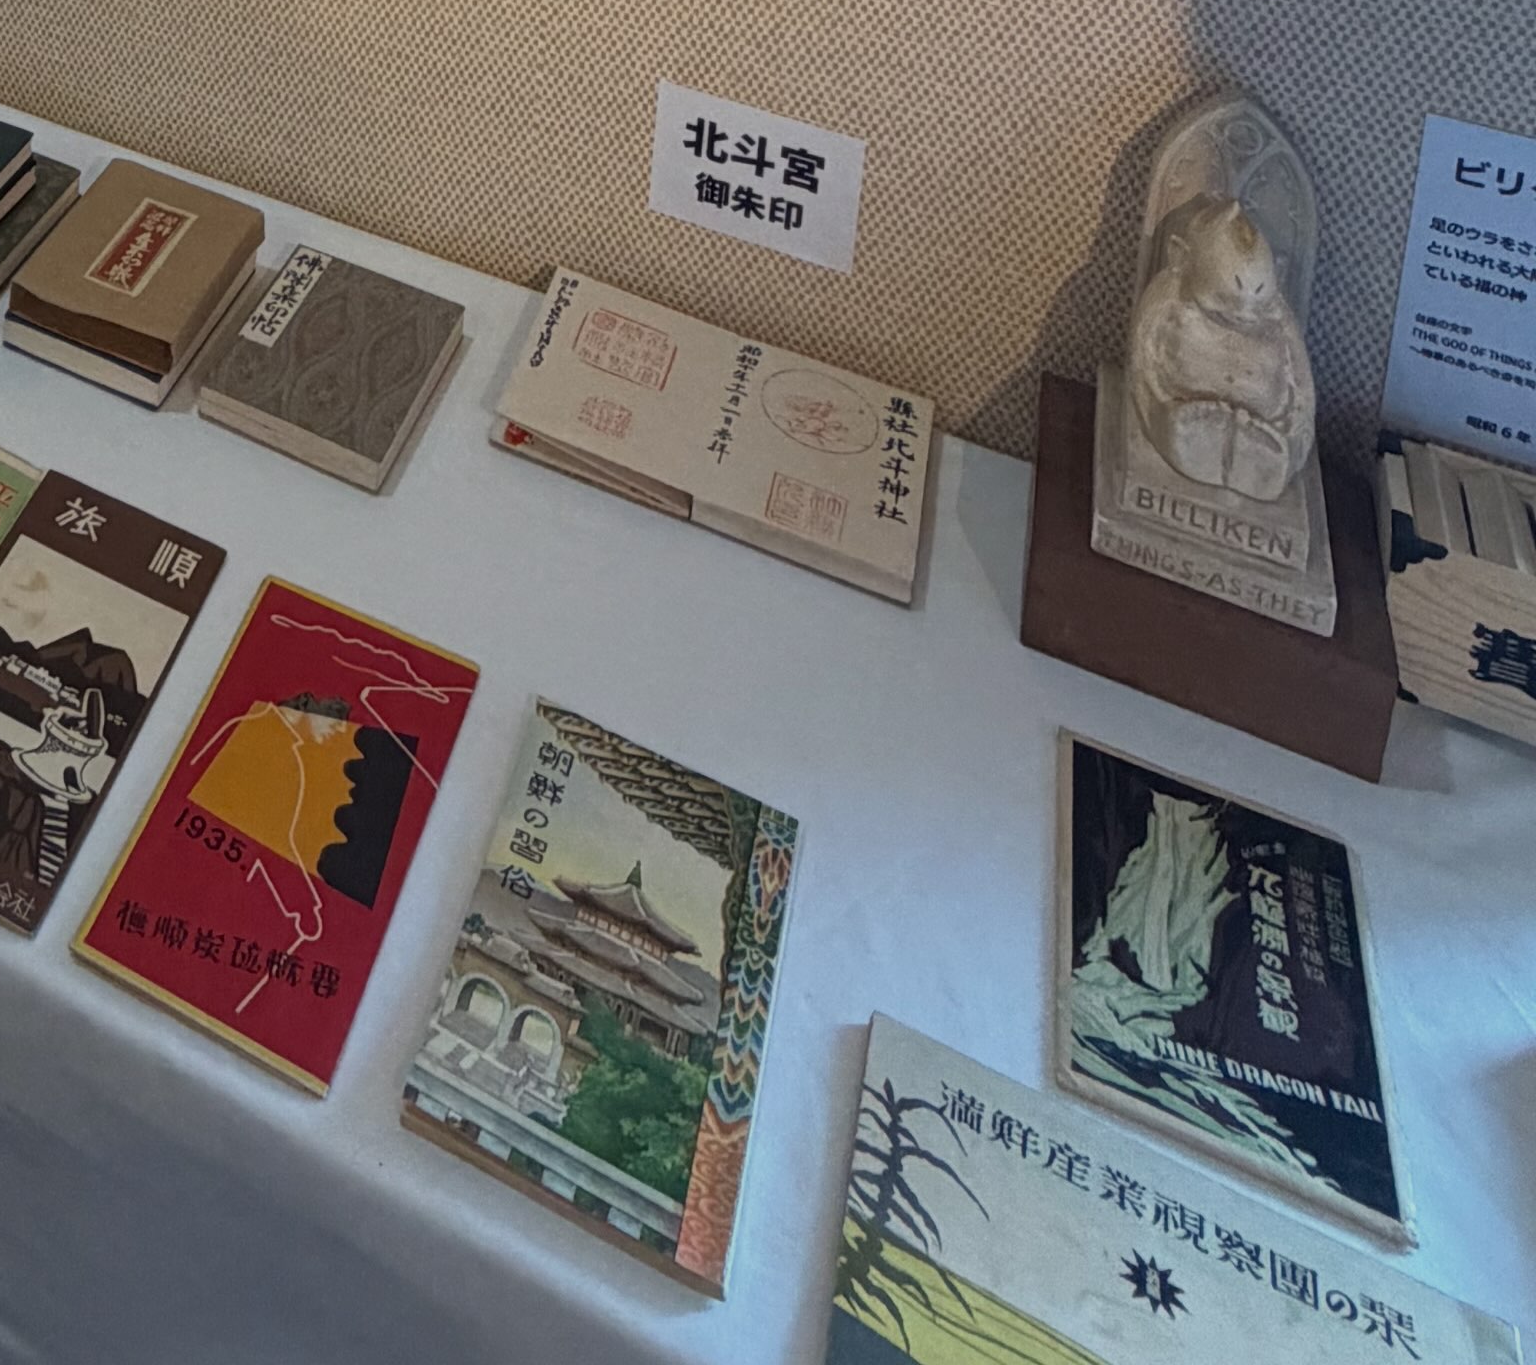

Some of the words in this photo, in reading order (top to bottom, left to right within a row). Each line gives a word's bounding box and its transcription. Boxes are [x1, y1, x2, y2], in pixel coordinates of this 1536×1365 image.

[683, 117, 826, 194] 北斗宮
[1455, 156, 1536, 197] ビリ
[695, 172, 804, 230] 御朱印
[1429, 216, 1536, 258] 足のウラをさ
[1441, 336, 1469, 352] GOD
[1470, 345, 1487, 357] OF
[1489, 350, 1533, 371] THINGS
[1136, 486, 1293, 560] BILLIKEN
[1155, 1036, 1220, 1069] NINE
[1226, 1055, 1326, 1107] DRAGON
[1329, 1088, 1383, 1123] FALL
